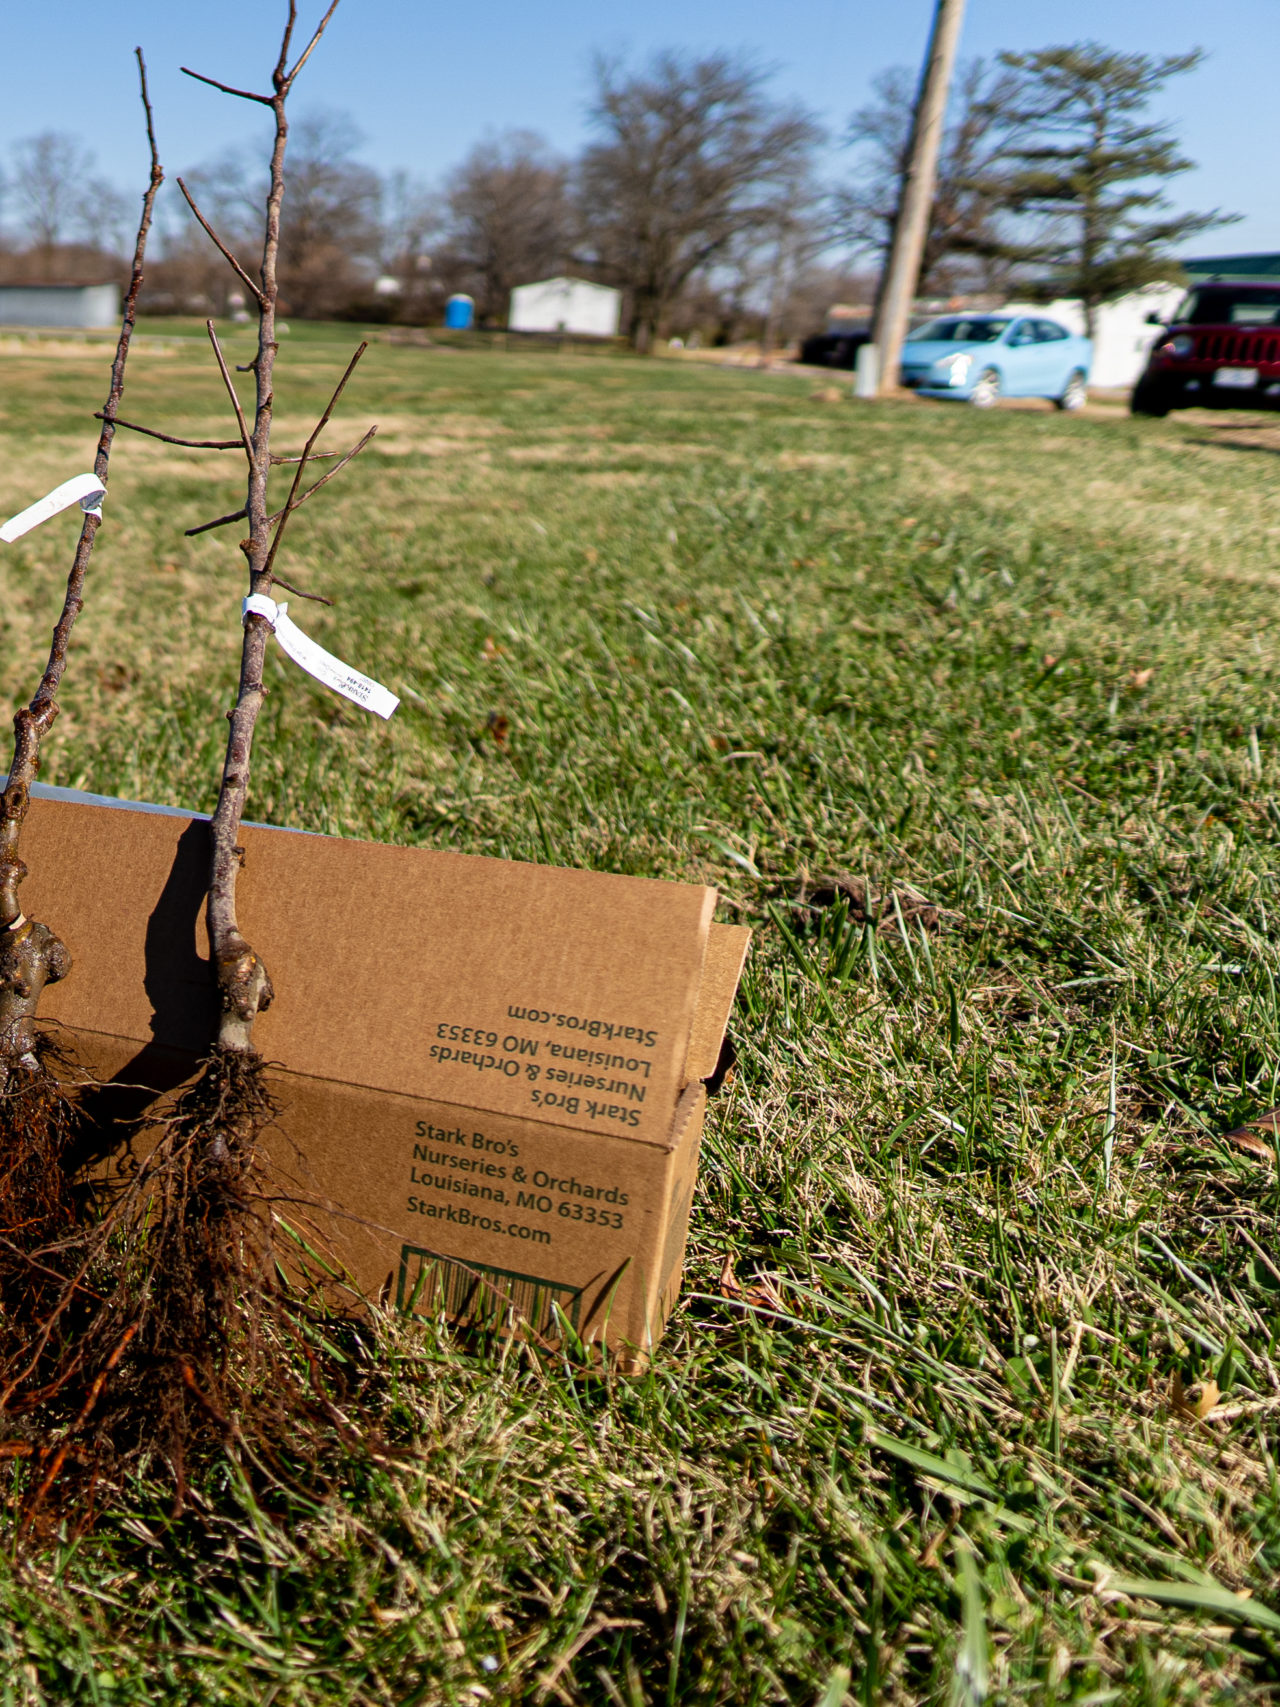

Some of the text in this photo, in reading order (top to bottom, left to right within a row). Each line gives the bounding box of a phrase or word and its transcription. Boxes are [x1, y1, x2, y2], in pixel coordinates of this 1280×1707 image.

[436, 1023, 652, 1078] Louisiana, MO 63353
[508, 1005, 658, 1047] StarkBros.com
[429, 1044, 646, 1102] Nurseries & Orchards
[531, 1089, 641, 1127] Stark Bro's
[415, 1121, 519, 1158] Stark Bro's
[410, 1167, 624, 1230] Louisiana, MO 63353
[412, 1144, 629, 1207] Nurseries & Orchards
[407, 1196, 552, 1245] StarkBros.com
